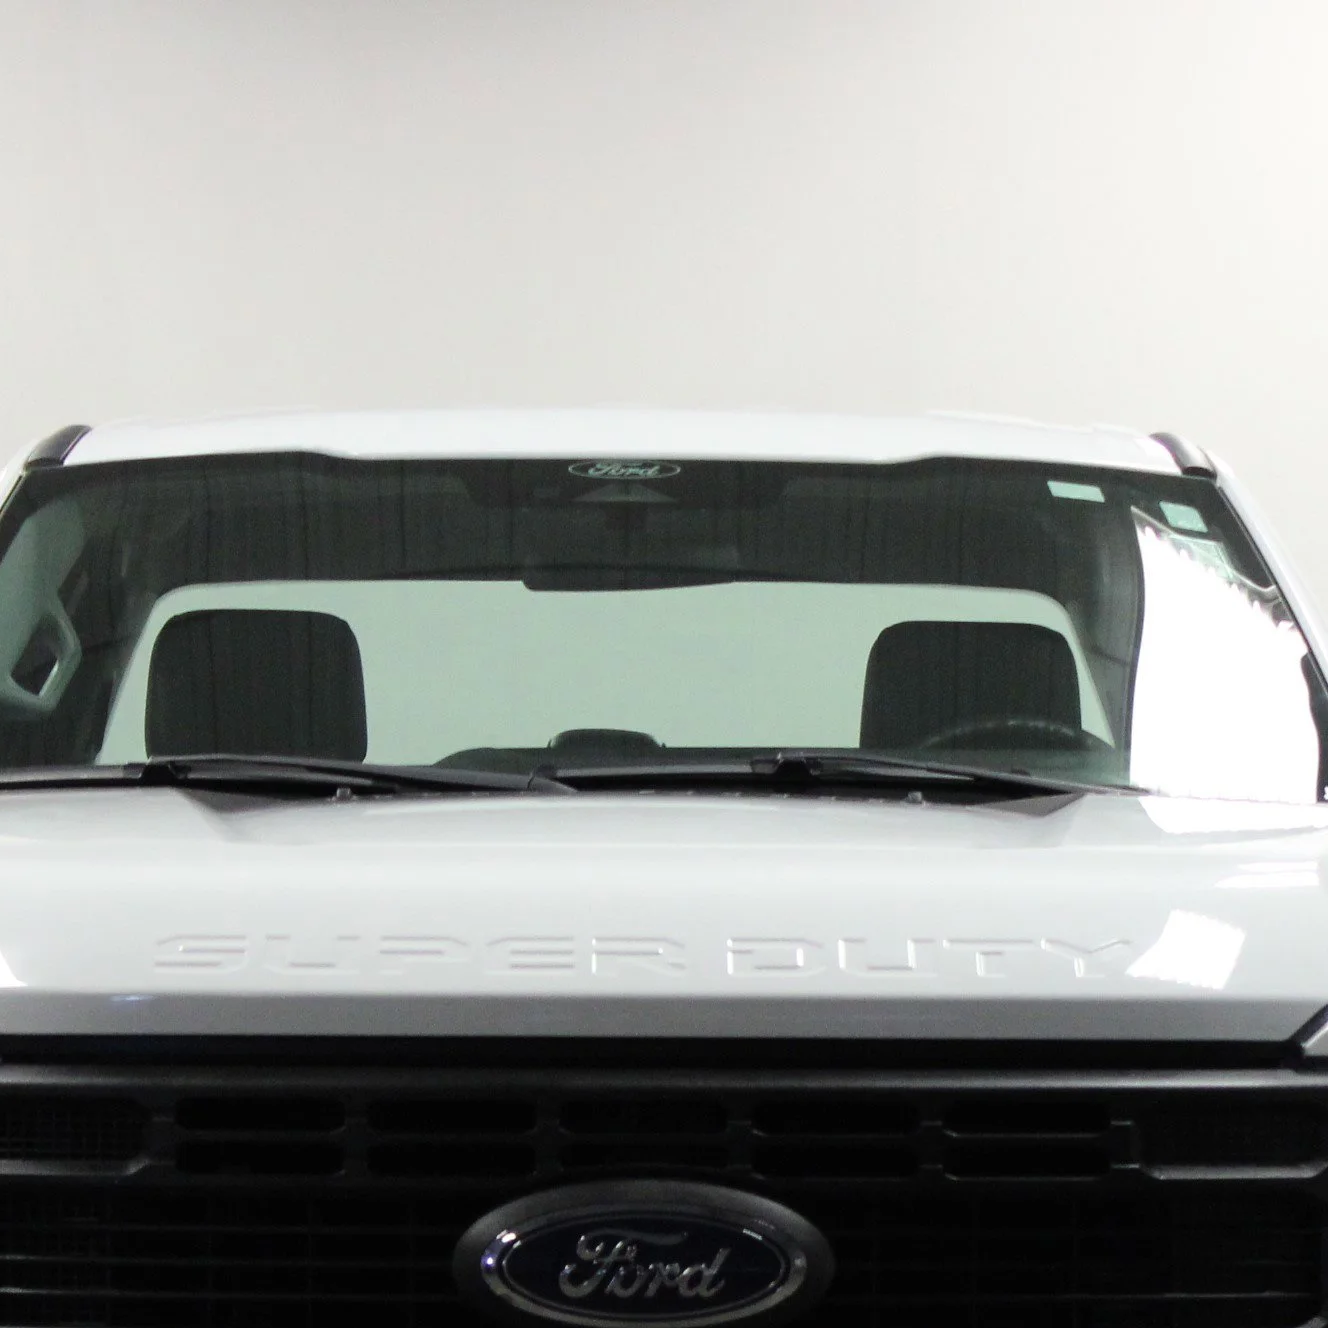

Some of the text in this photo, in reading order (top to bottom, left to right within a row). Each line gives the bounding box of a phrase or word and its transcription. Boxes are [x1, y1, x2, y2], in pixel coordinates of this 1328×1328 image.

[587, 460, 661, 477] Ford
[154, 934, 1132, 978] SUPER DUTY
[558, 1227, 732, 1299] Ford
